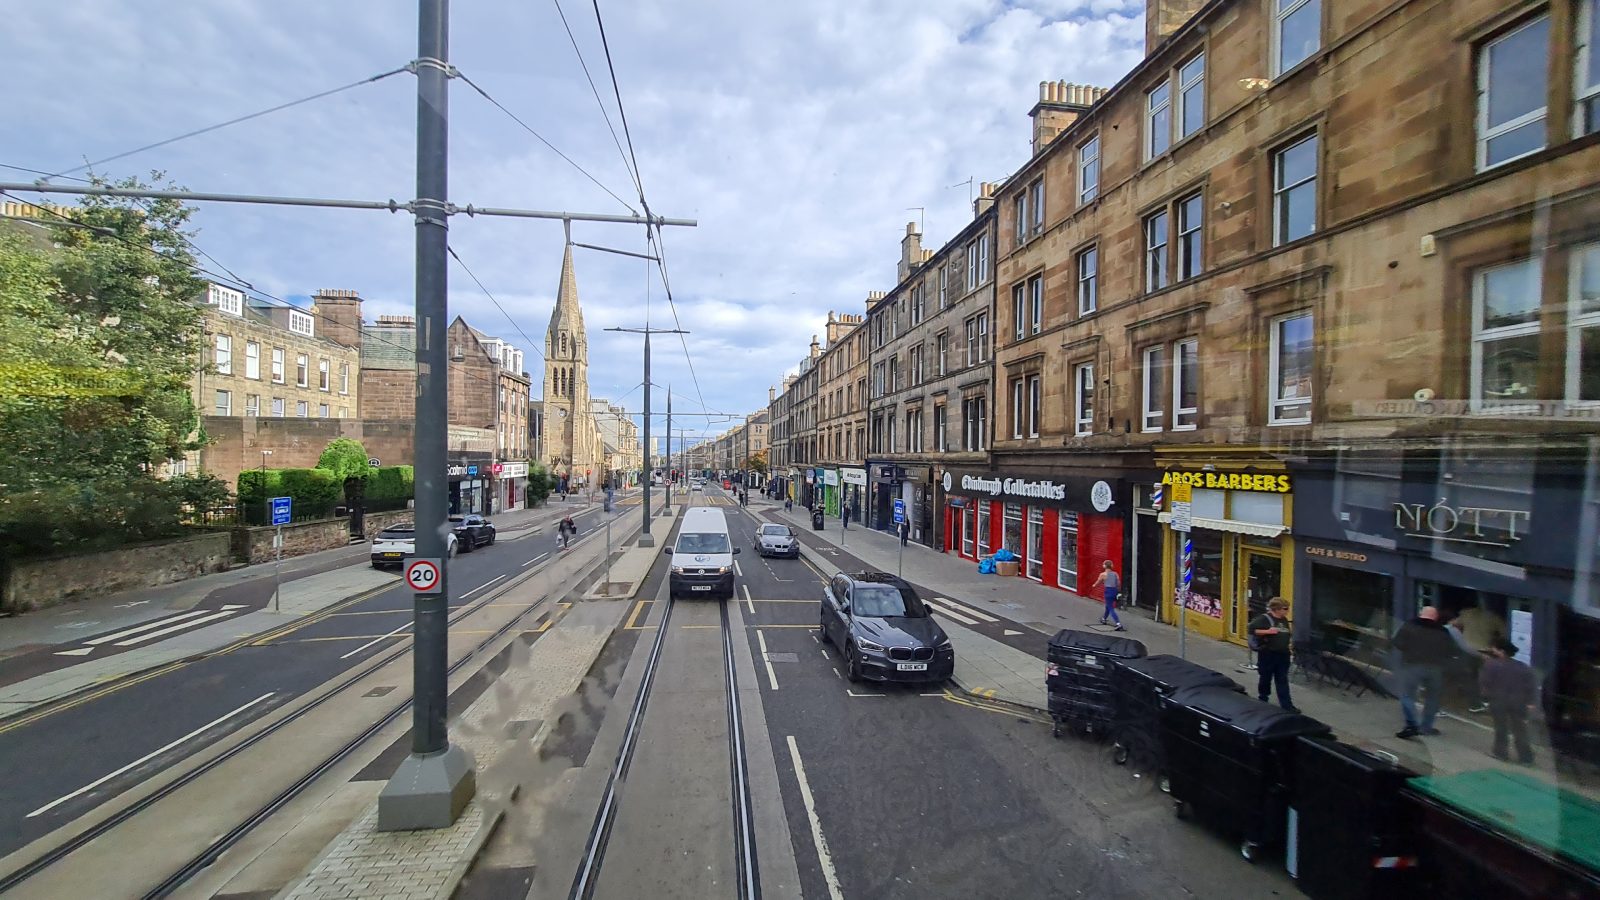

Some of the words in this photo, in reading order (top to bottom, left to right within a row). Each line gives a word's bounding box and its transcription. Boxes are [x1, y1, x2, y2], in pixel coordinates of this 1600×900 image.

[961, 475, 1002, 496] Edinburgh
[1003, 478, 1066, 500] Collectables
[1161, 472, 1205, 488] AROS
[1205, 473, 1290, 493] BARBERS
[1393, 497, 1531, 541] NÓTT
[1326, 549, 1334, 557] &
[1335, 551, 1367, 562] BISTRO
[412, 569, 434, 582] 20
